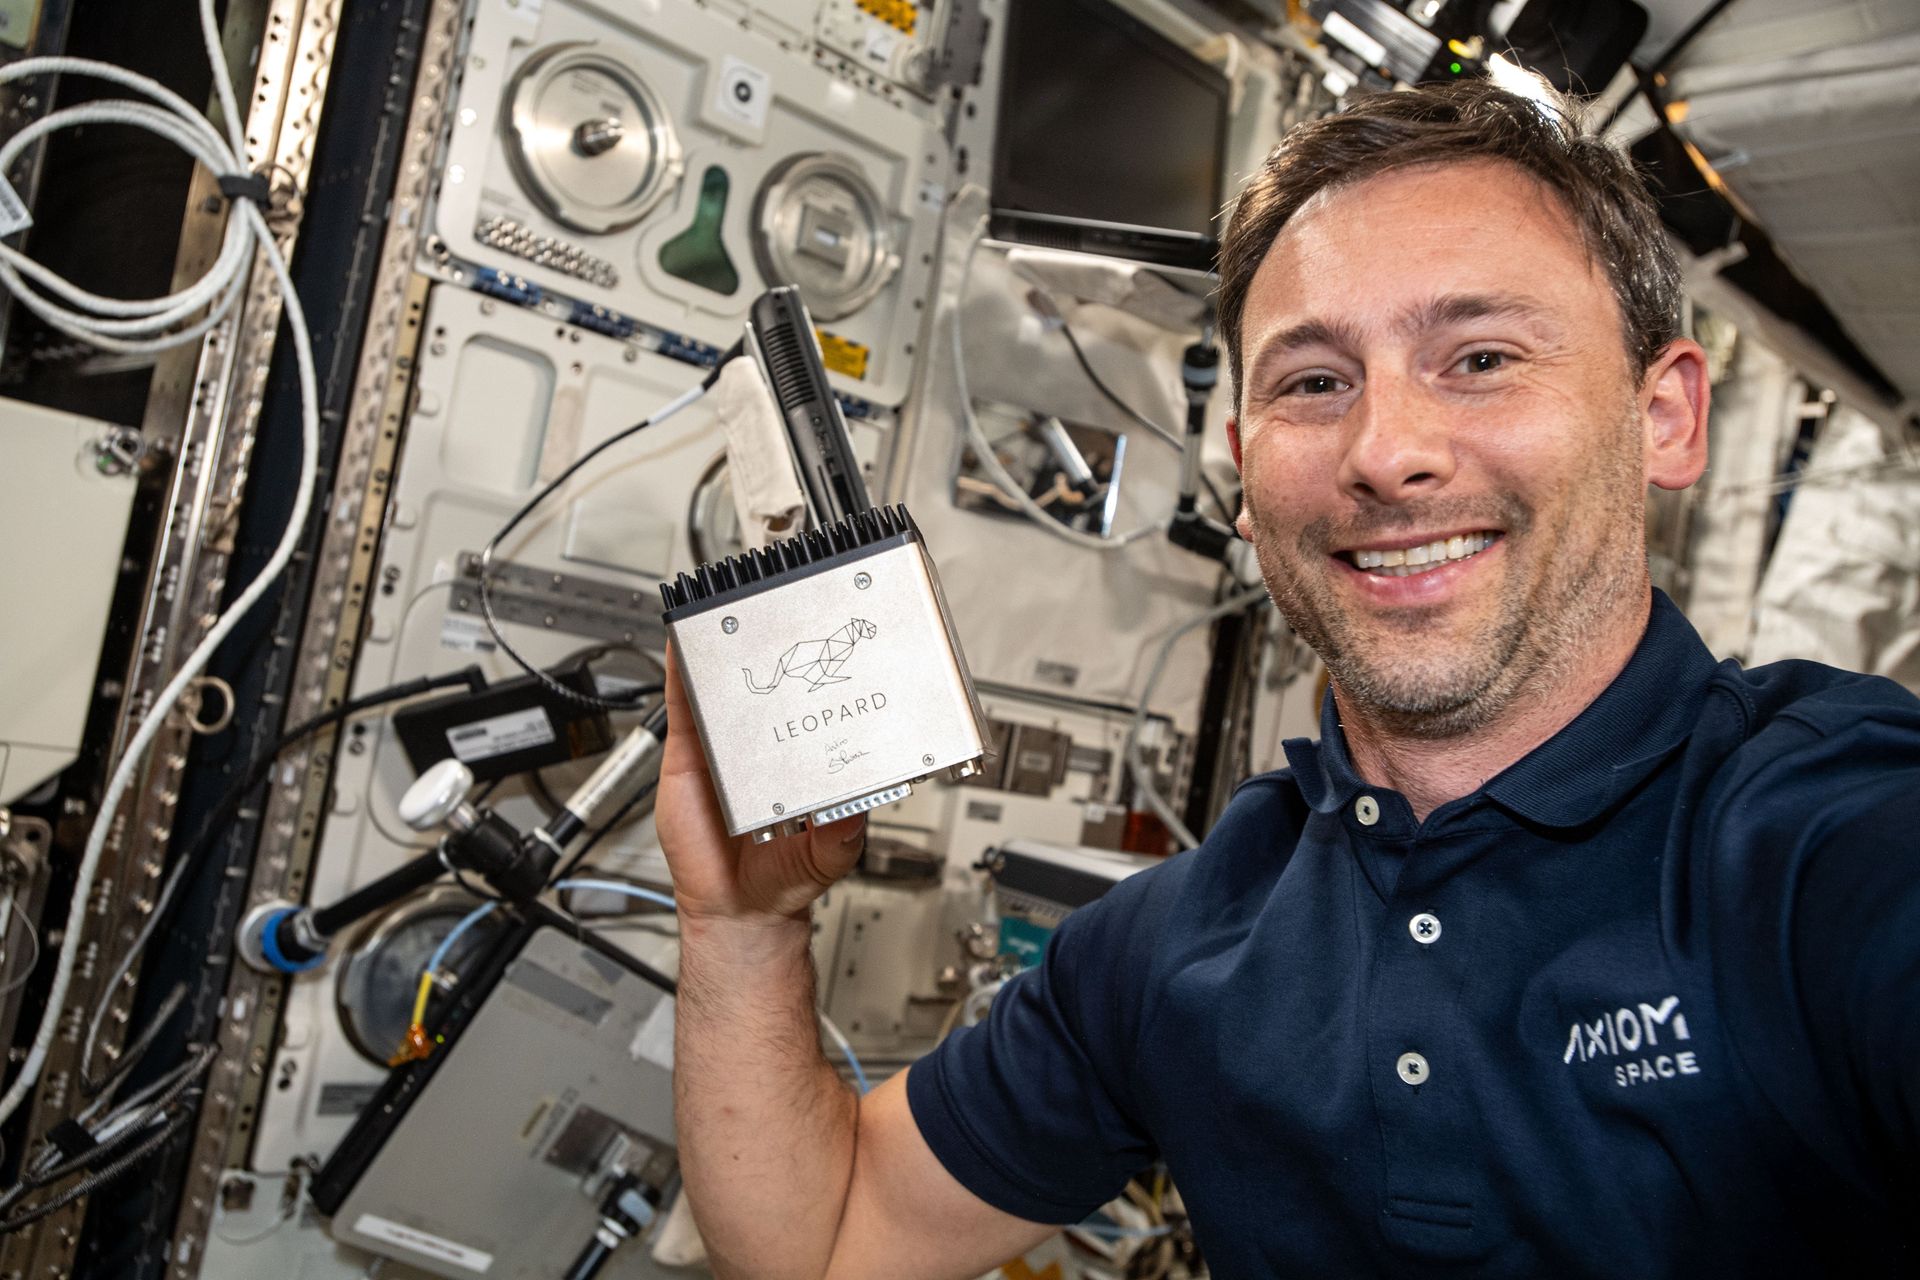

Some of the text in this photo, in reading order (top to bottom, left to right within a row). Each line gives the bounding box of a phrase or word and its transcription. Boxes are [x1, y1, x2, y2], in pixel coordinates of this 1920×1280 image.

[773, 692, 887, 743] LEOPARD
[1563, 995, 1691, 1065] AXIOM
[1615, 1051, 1701, 1087] SPACE
